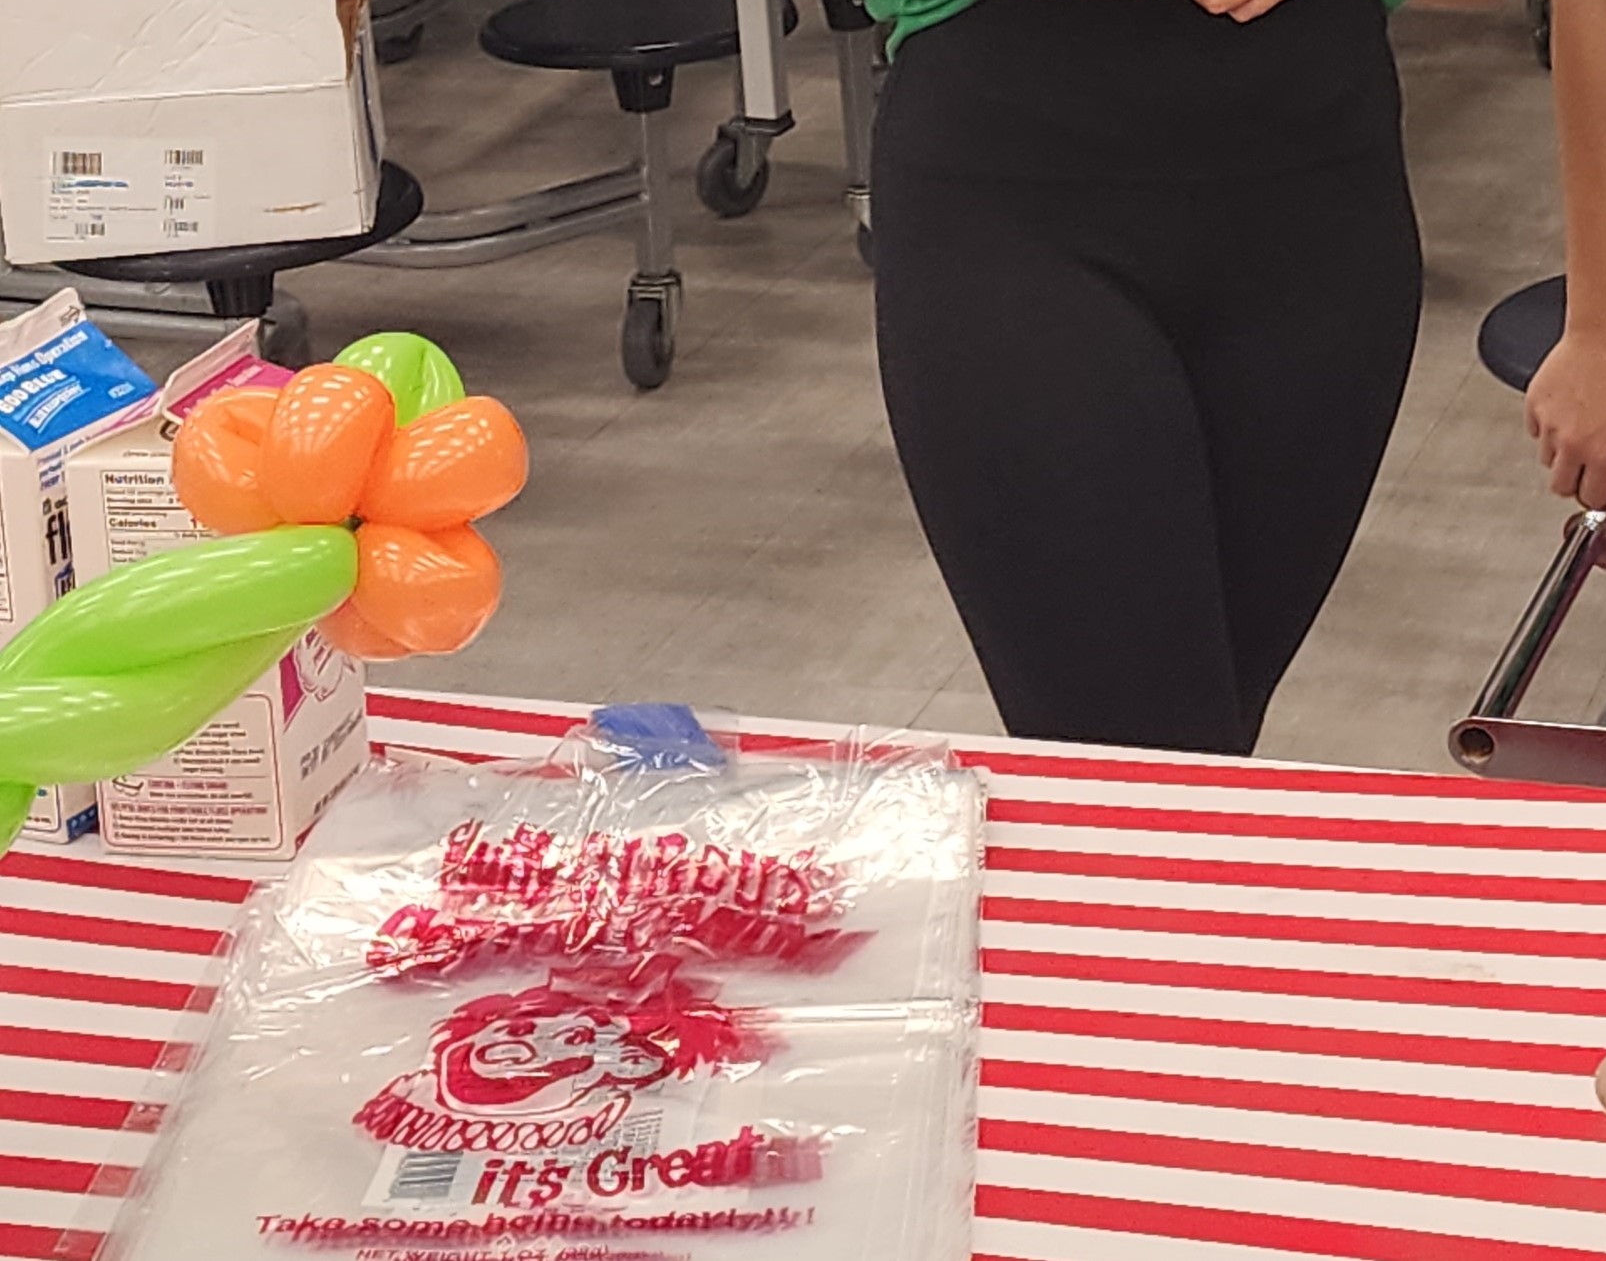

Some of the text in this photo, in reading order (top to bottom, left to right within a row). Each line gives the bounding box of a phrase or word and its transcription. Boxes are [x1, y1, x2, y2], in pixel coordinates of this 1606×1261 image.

[34, 330, 88, 365] Operation
[105, 474, 165, 485] Nutrition
[109, 518, 157, 528] Calories
[472, 1125, 765, 1208] it's Great
[256, 1213, 346, 1242] Take
[357, 1216, 472, 1238] some
